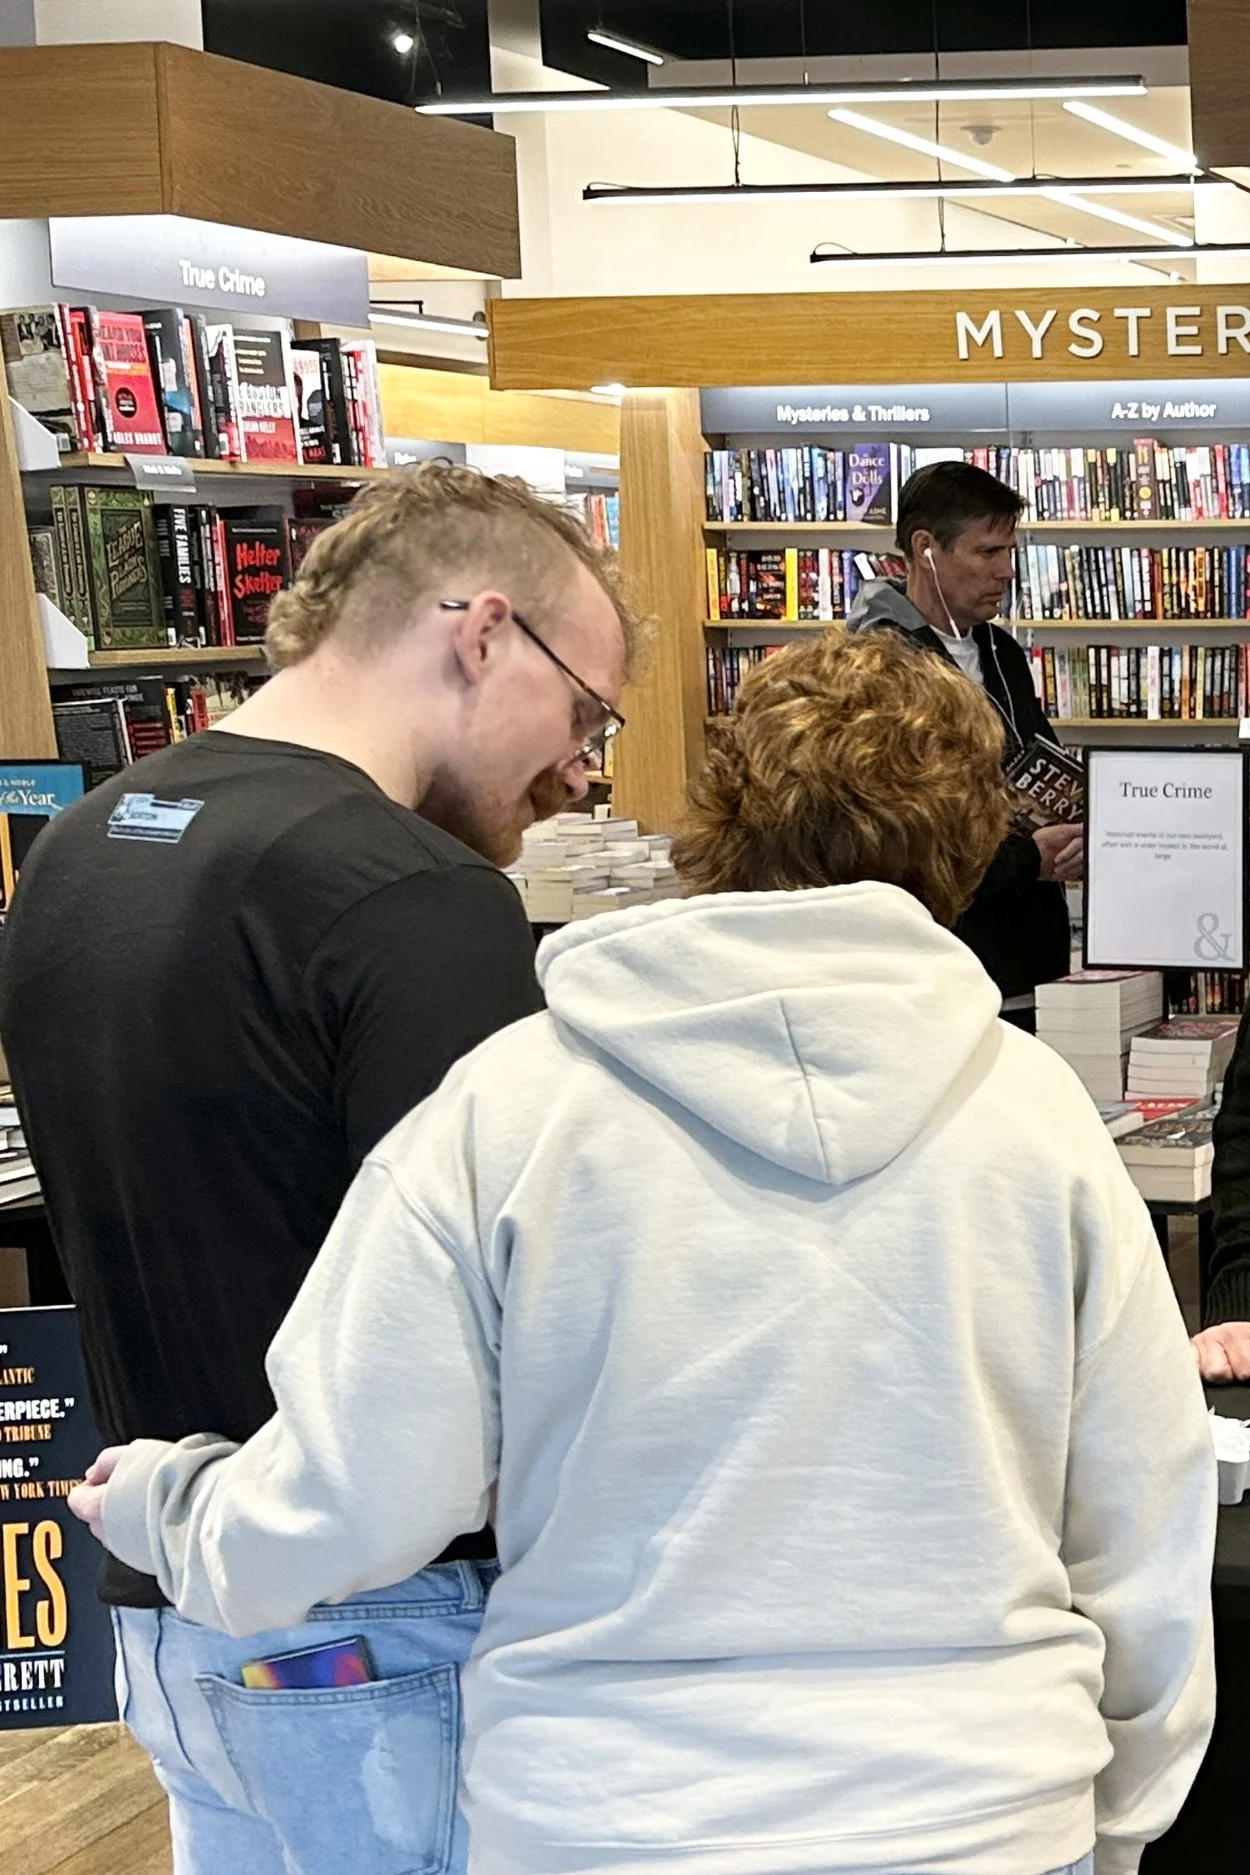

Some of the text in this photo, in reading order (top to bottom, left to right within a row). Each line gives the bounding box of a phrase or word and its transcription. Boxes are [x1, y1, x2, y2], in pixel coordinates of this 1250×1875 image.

[179, 259, 266, 297] True Crime
[777, 405, 930, 425] Mysteries & Thrillers
[1111, 401, 1217, 421] A-Z by Author
[849, 453, 886, 468] Dance
[852, 470, 884, 486] Dolls
[173, 508, 192, 584] FIVE FAMILIES
[235, 541, 281, 571] Helter
[233, 572, 283, 600] Skelter
[18, 789, 64, 811] Year
[1015, 772, 1084, 821] BERRY
[1120, 781, 1213, 800] True Crime
[1193, 912, 1236, 962] &
[4, 1423, 52, 1443] TRIBUNE
[14, 1478, 82, 1500] YORK TIM
[2, 1519, 68, 1650] ES
[0, 1658, 66, 1693] RETT
